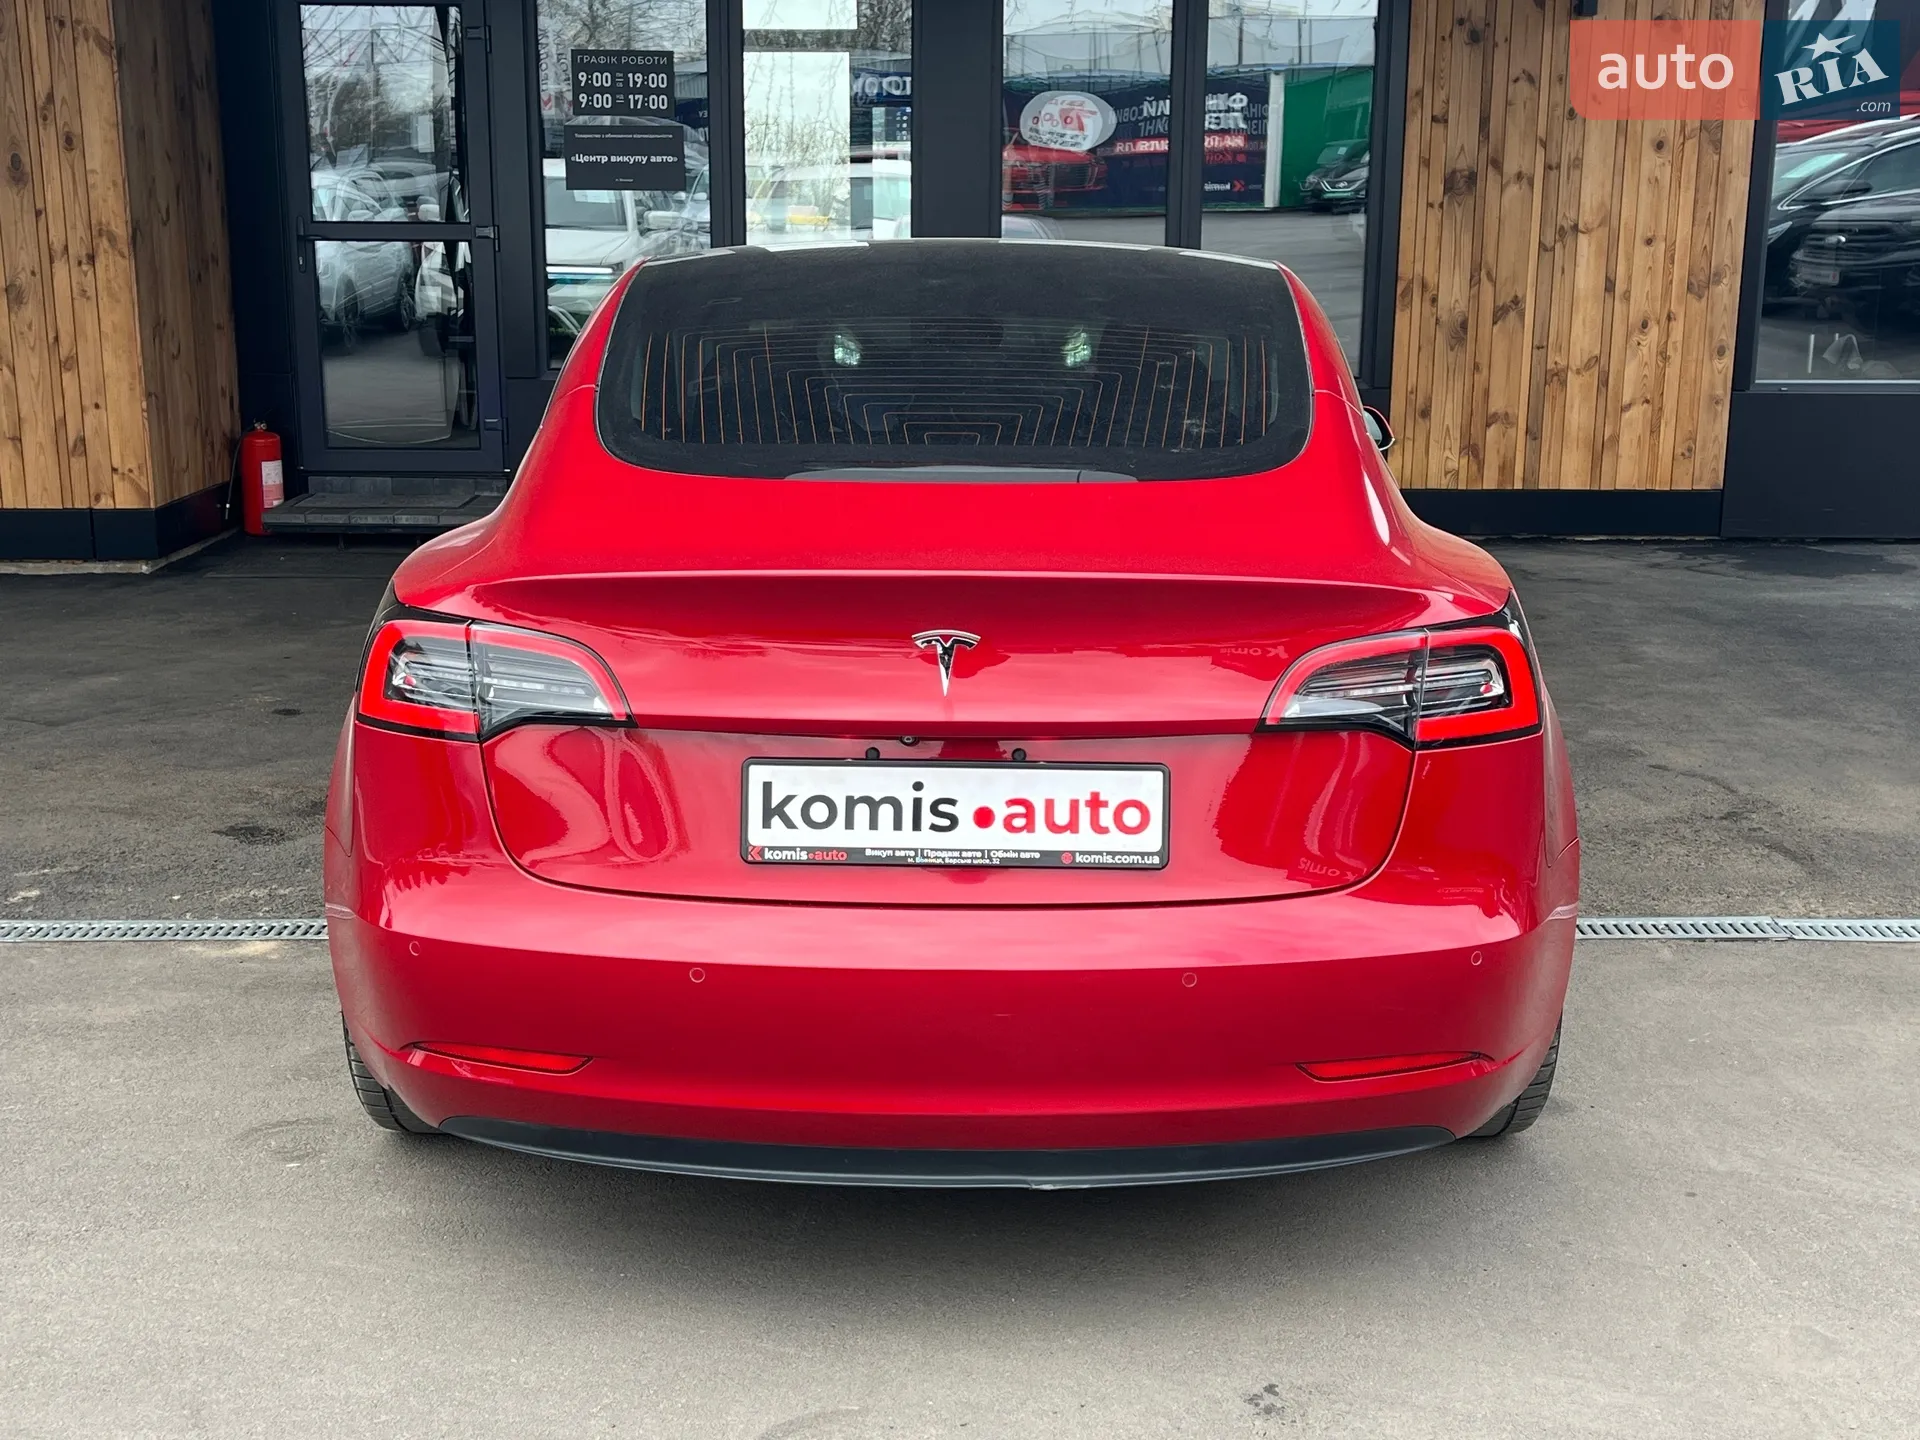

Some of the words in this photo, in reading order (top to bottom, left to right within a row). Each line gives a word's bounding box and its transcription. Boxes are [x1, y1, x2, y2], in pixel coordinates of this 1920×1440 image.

[577, 55, 618, 64] ГРАФІК
[621, 56, 668, 65] РОБОТИ
[578, 71, 612, 87] 9:00
[627, 72, 668, 88] 19:00
[578, 93, 612, 108] 9:00
[628, 94, 668, 110] 17:00
[571, 153, 608, 164] «Центр
[610, 154, 648, 164] викупу
[650, 155, 678, 163] авто»
[762, 781, 959, 833] komis
[1003, 791, 1151, 836] auto
[923, 849, 960, 859] Продаж
[990, 850, 1018, 858] Обмін
[1075, 852, 1160, 864] komis.com.ua
